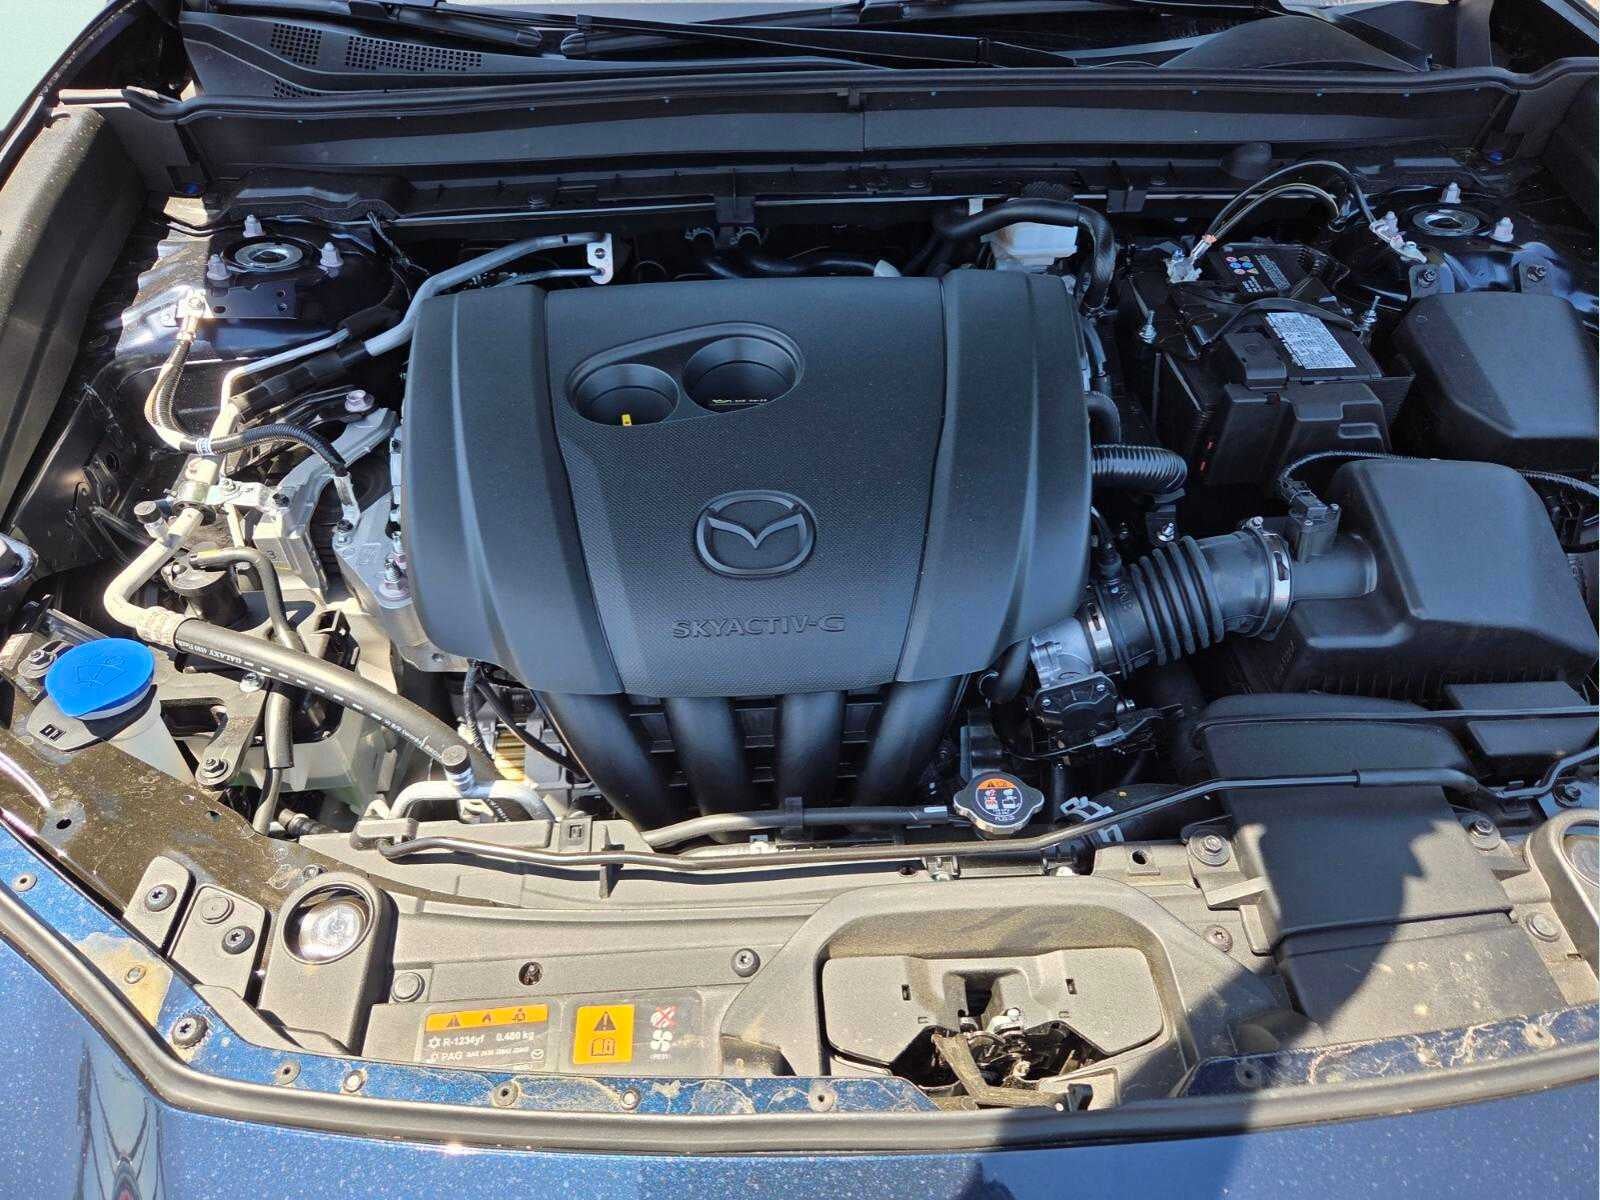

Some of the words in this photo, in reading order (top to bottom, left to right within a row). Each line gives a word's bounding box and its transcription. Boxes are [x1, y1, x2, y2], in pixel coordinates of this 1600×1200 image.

[672, 613, 847, 639] SKYACTIV-G
[442, 1034, 485, 1047] R-1234yf
[522, 1030, 535, 1041] kg
[441, 1051, 463, 1061] PAG
